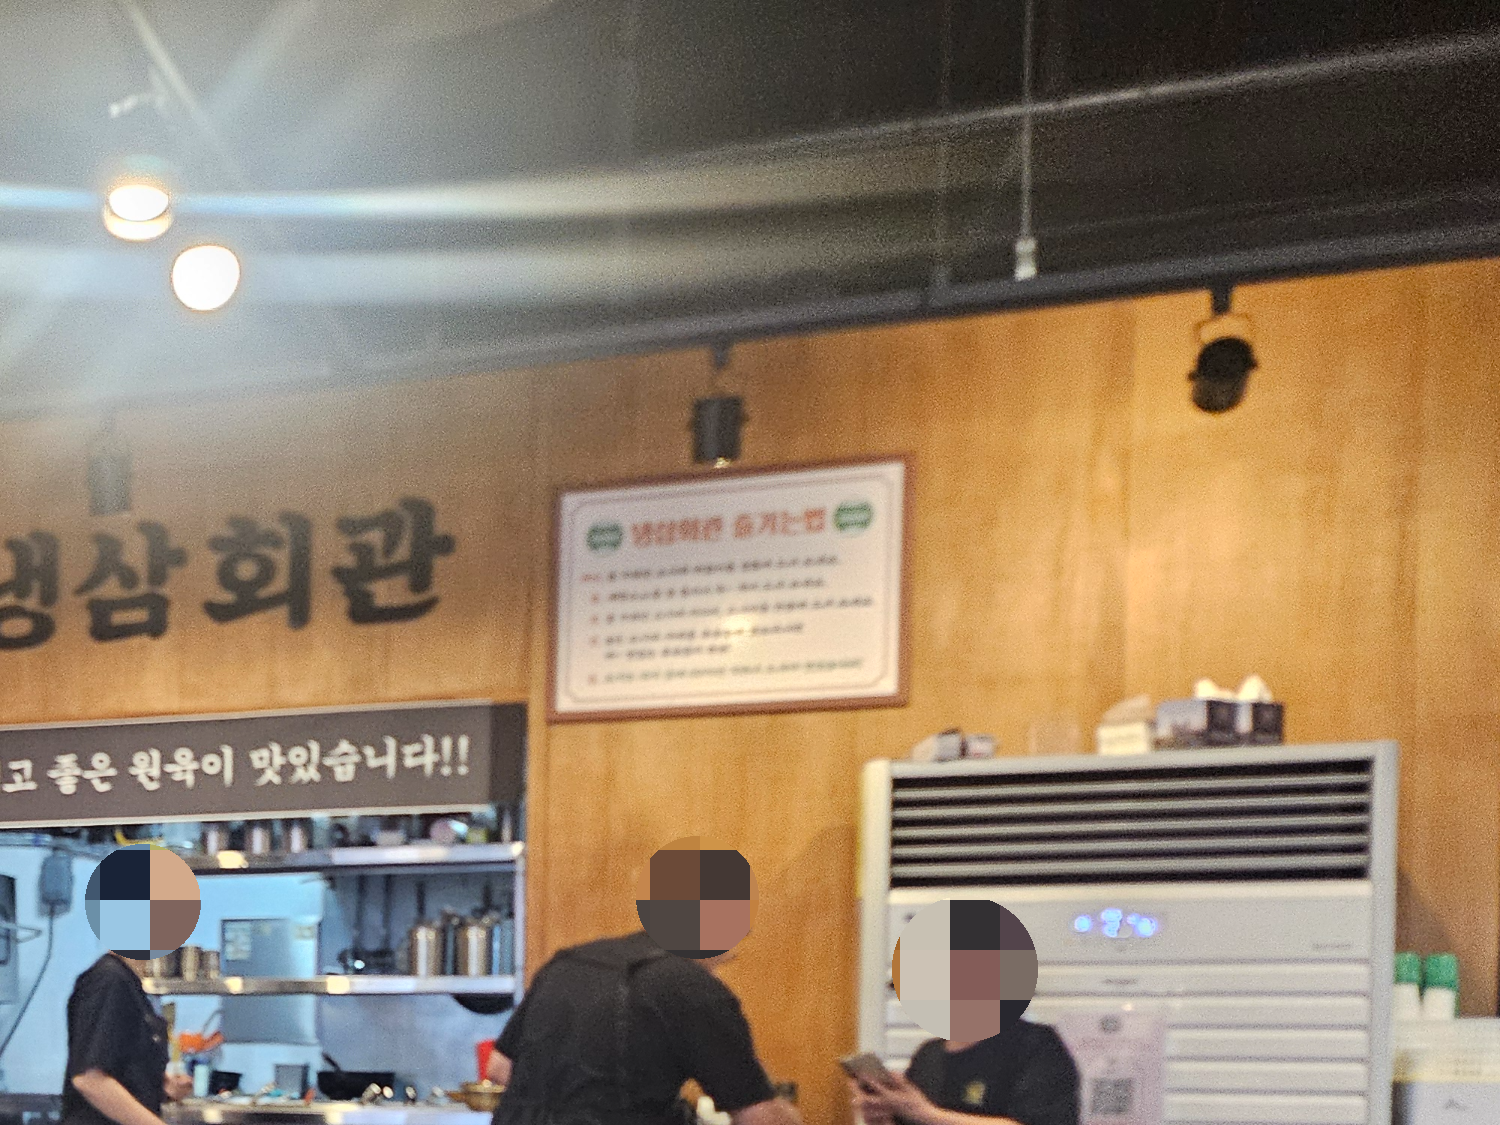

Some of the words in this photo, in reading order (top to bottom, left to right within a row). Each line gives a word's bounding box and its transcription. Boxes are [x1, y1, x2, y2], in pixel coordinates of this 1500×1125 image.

[47, 753, 117, 795] 좋은
[128, 745, 235, 792] 원육이
[249, 733, 470, 787] 맛있습니다!!
